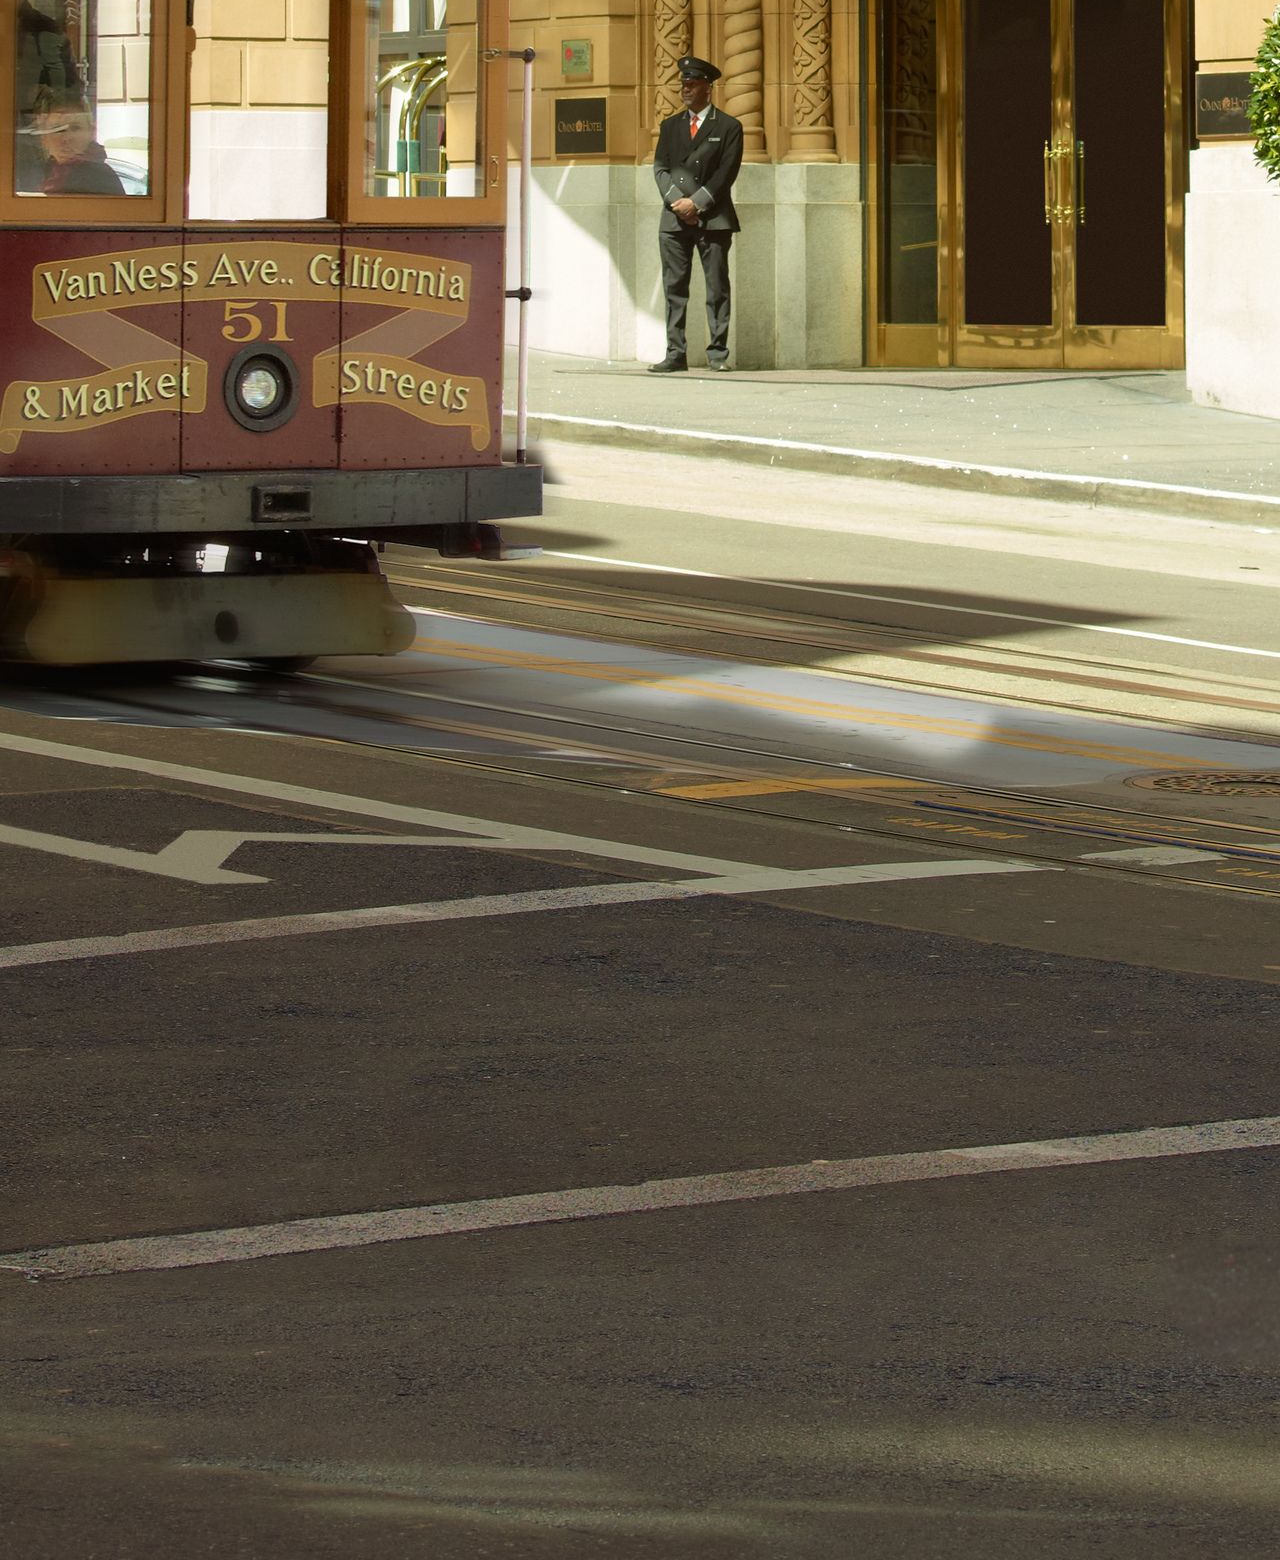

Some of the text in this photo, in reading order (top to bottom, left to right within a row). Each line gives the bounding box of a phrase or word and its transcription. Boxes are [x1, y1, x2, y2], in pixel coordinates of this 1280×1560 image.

[40, 267, 108, 305] Van
[113, 256, 198, 294] Ness
[308, 251, 467, 302] California
[221, 301, 294, 342] 51
[21, 365, 192, 420] & Market
[341, 359, 471, 412] Streets
